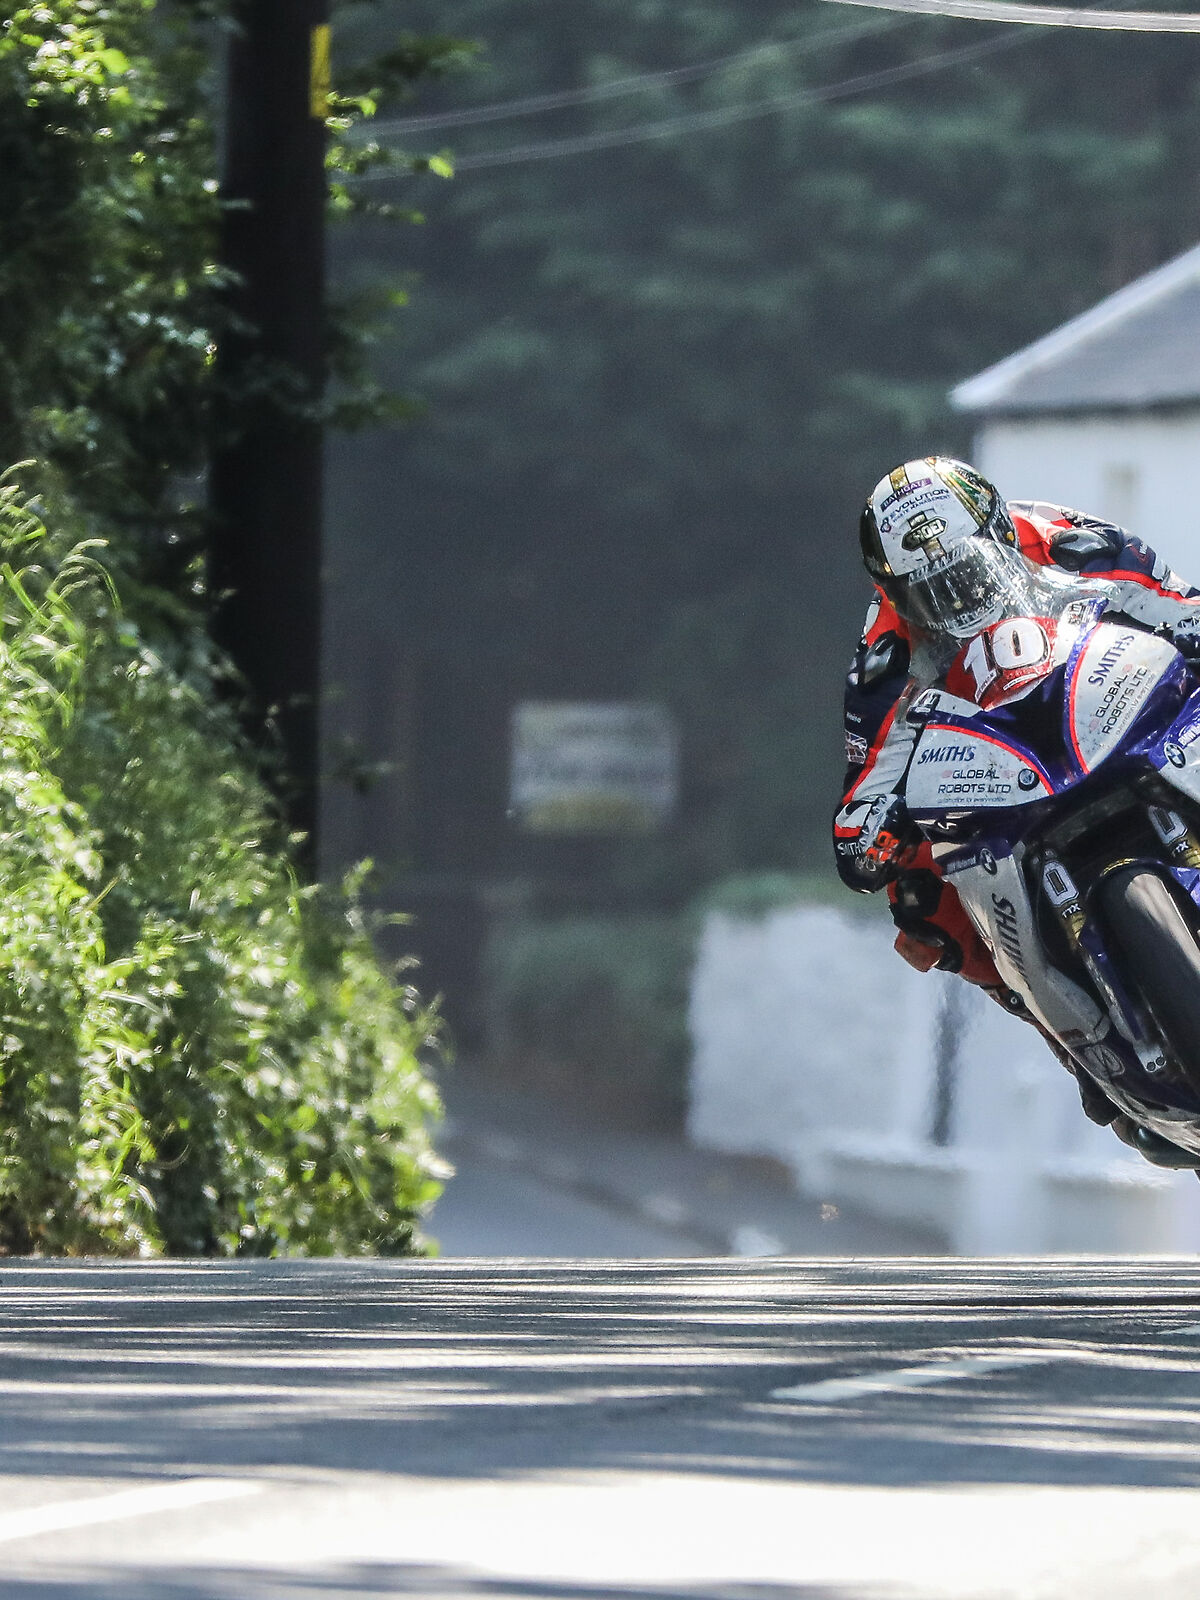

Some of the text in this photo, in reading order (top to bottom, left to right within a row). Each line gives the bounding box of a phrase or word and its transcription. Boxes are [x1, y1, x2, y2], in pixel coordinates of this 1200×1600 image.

[890, 488, 949, 519] EVOLUTION
[963, 617, 1051, 703] 10
[1087, 633, 1135, 688] SMITHS
[1095, 674, 1128, 718] GLOBAL
[1101, 688, 1135, 734] ROBOTS
[917, 746, 976, 765] SMITHS
[952, 769, 1000, 780] GLOBAL
[938, 783, 1012, 794] ROBOTS LTD
[837, 838, 867, 856] STHS
[1061, 903, 1082, 919] TTX
